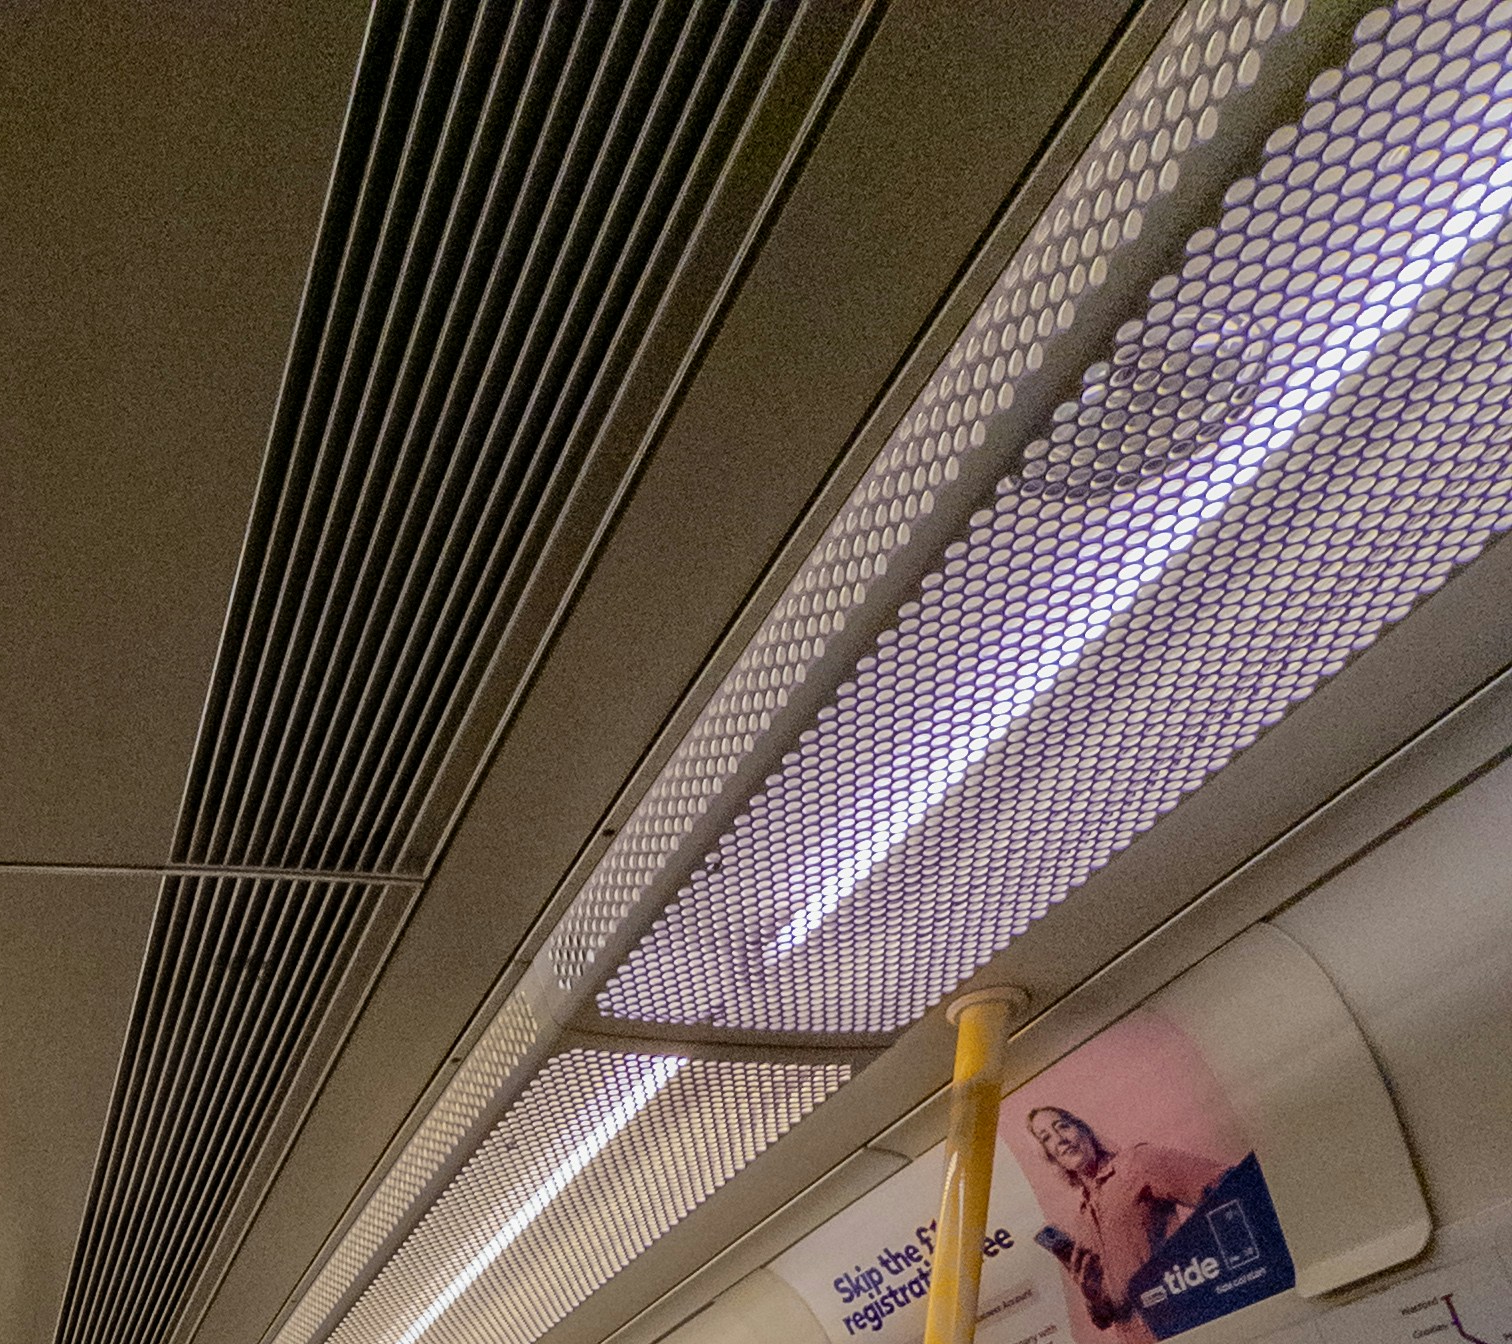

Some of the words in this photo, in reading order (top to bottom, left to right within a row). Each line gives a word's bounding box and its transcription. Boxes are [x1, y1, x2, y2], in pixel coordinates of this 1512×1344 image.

[834, 1265, 884, 1303] Skip
[877, 1247, 924, 1275] the
[842, 1261, 931, 1335] registrat
[982, 1228, 1014, 1257] ee
[1163, 1256, 1220, 1295] tide
